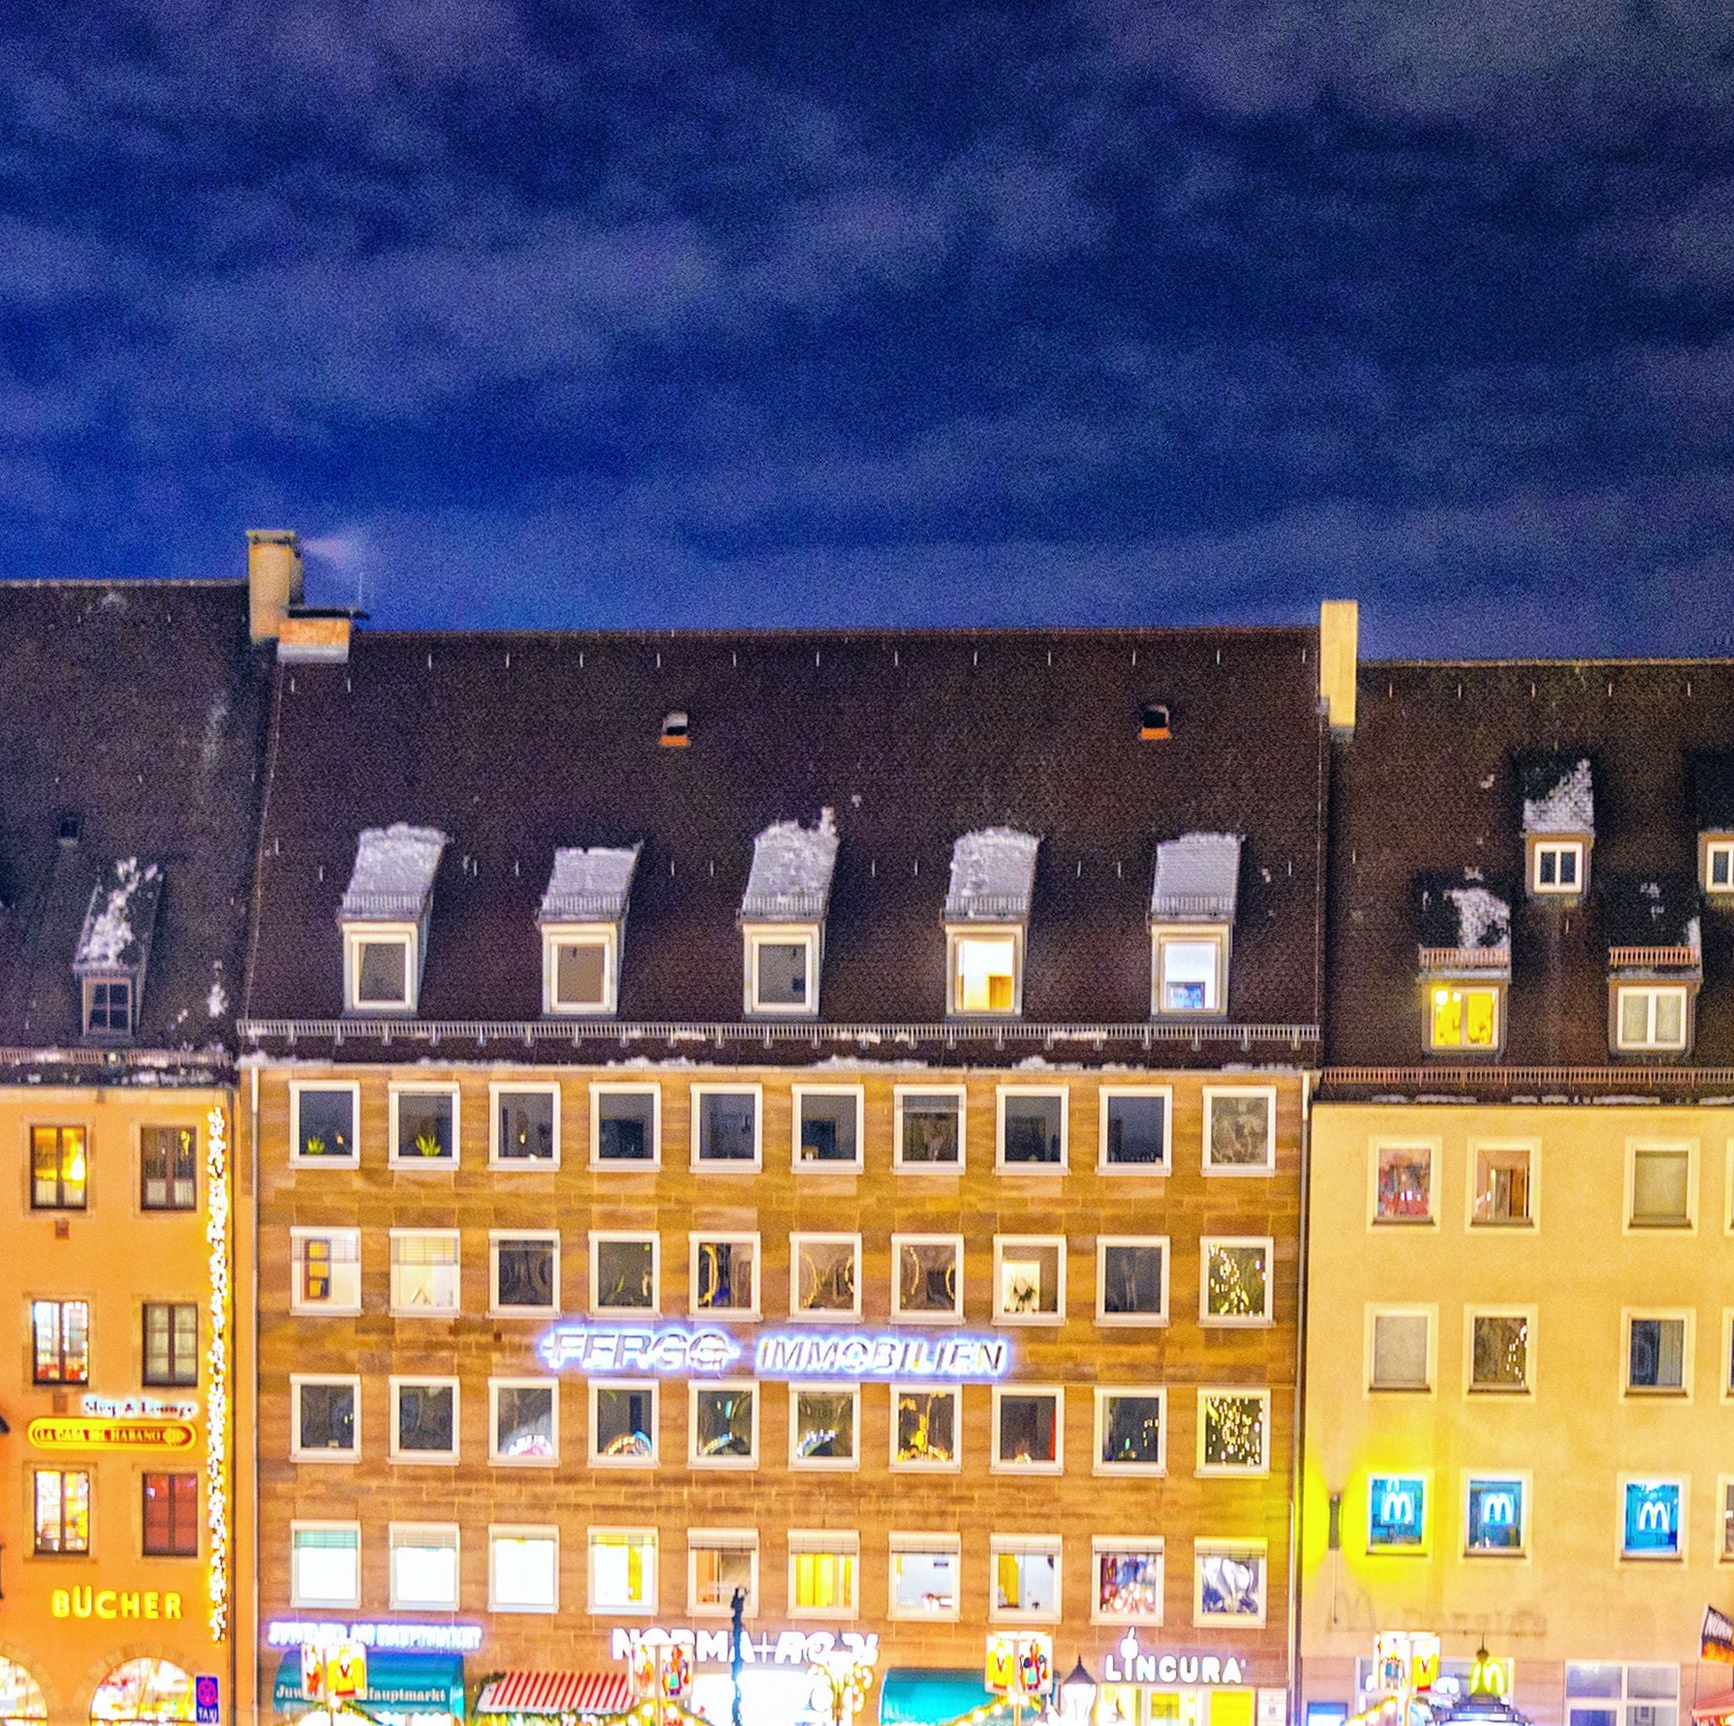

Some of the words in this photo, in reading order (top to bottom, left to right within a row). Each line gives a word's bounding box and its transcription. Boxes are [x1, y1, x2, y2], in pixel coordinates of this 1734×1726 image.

[758, 1336, 1005, 1373] IMMOBILIEN
[1105, 1637, 1242, 1684] LINCURA
[367, 1686, 446, 1703] auptmarkt
[197, 1708, 218, 1723] TAXI
